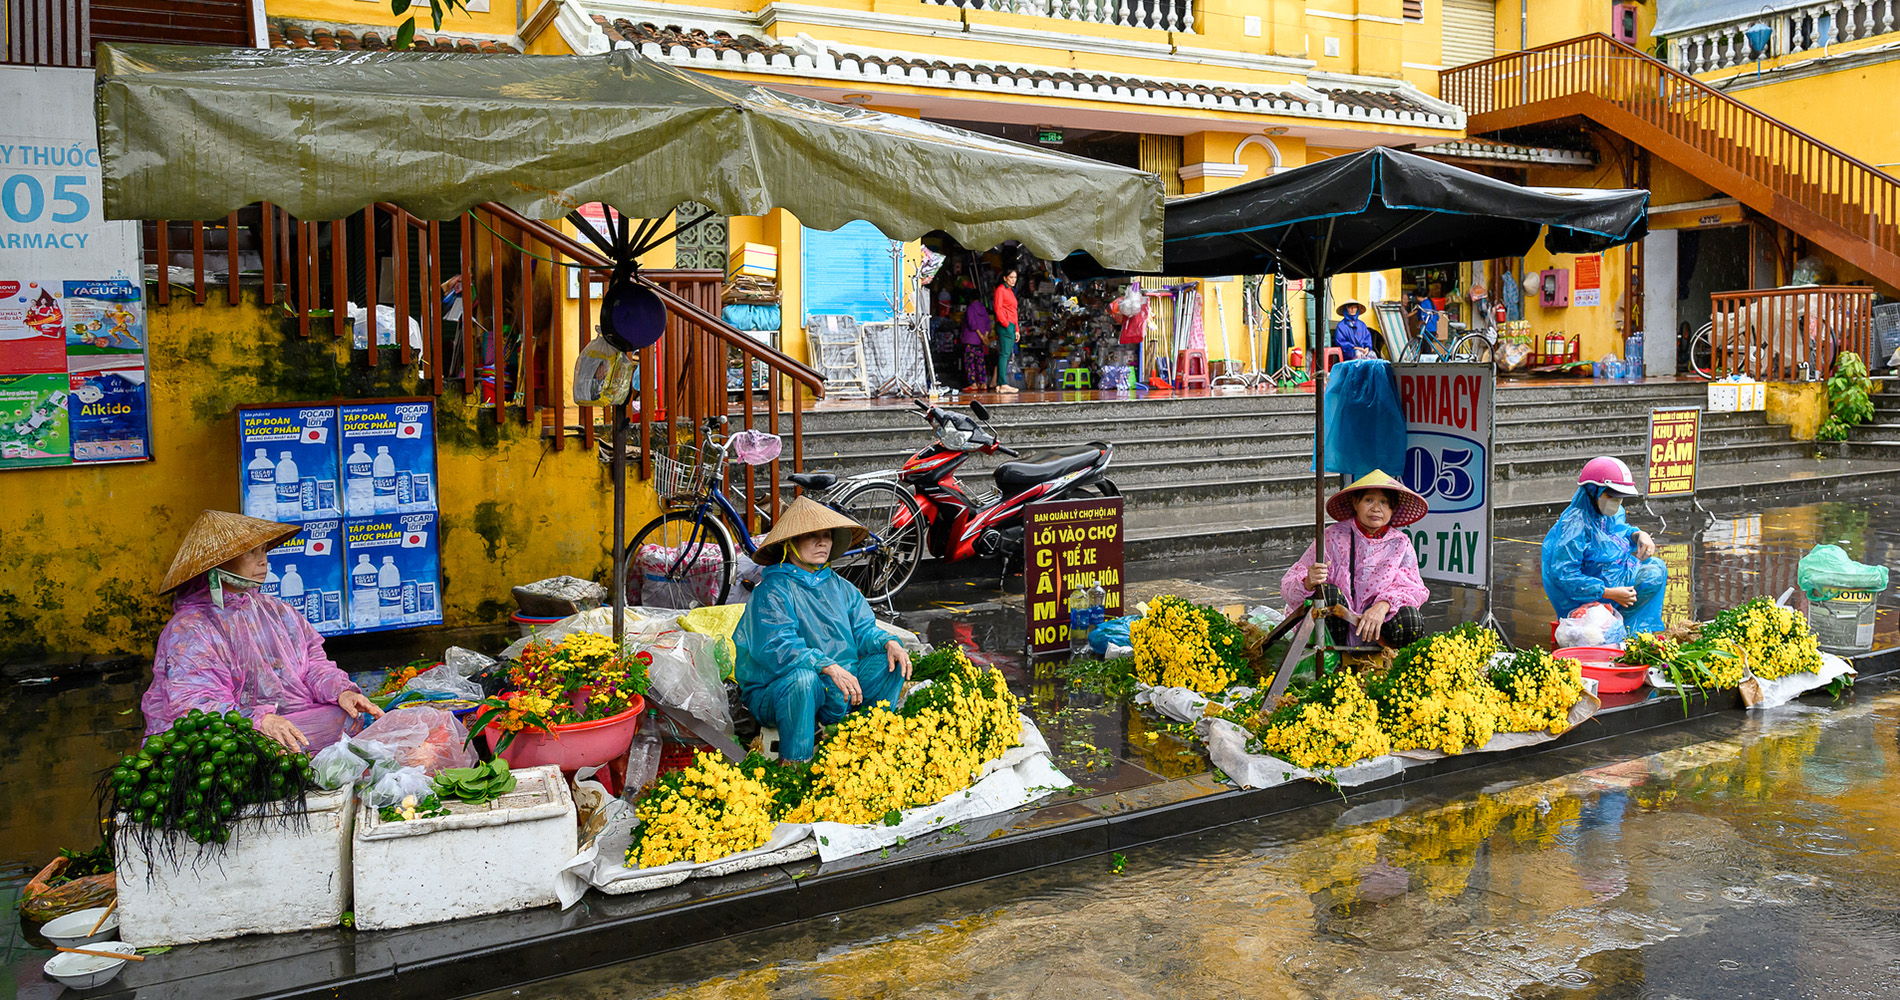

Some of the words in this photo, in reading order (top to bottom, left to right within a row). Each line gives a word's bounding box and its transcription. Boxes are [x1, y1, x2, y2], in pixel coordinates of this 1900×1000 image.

[0, 145, 14, 164] Y
[19, 142, 98, 167] THUỐC
[2, 174, 90, 223] 05
[1393, 374, 1482, 432] RMACY
[81, 403, 131, 416] Aikido
[300, 410, 333, 418] POCARI
[396, 406, 428, 414] POCARI
[263, 417, 290, 425] ĐOÀN
[344, 422, 369, 431] DƯỢC
[371, 420, 396, 429] PHẨM
[245, 427, 272, 436] DƯỢC
[274, 424, 300, 434] PHẨM
[1653, 425, 1673, 439] KHU
[1675, 423, 1694, 440] VỰC
[1651, 437, 1693, 463] CẤM
[1650, 482, 1660, 492] NO
[1661, 480, 1690, 492] PARKING
[401, 514, 433, 523] POCARI
[1034, 513, 1048, 522] BAN
[1050, 510, 1069, 521] QUẢN
[1070, 509, 1078, 520] LÝ
[1079, 508, 1094, 520] CHỢ
[1094, 506, 1106, 518] HỘI
[1107, 508, 1116, 516] AN
[304, 521, 338, 530] POCARI
[367, 523, 392, 531] ĐOÀN
[349, 534, 374, 542] DƯỢC
[376, 530, 401, 539] PHẨM
[1034, 526, 1056, 546] LỐI
[1058, 525, 1085, 543] VÀO
[1088, 524, 1117, 542] CHỢ
[278, 537, 304, 547] HẨM
[1437, 523, 1479, 574] TÂY
[1083, 548, 1096, 565] XE
[1099, 566, 1119, 586] HÓA
[1835, 591, 1871, 599] JOTUN
[1034, 625, 1056, 645] NO
